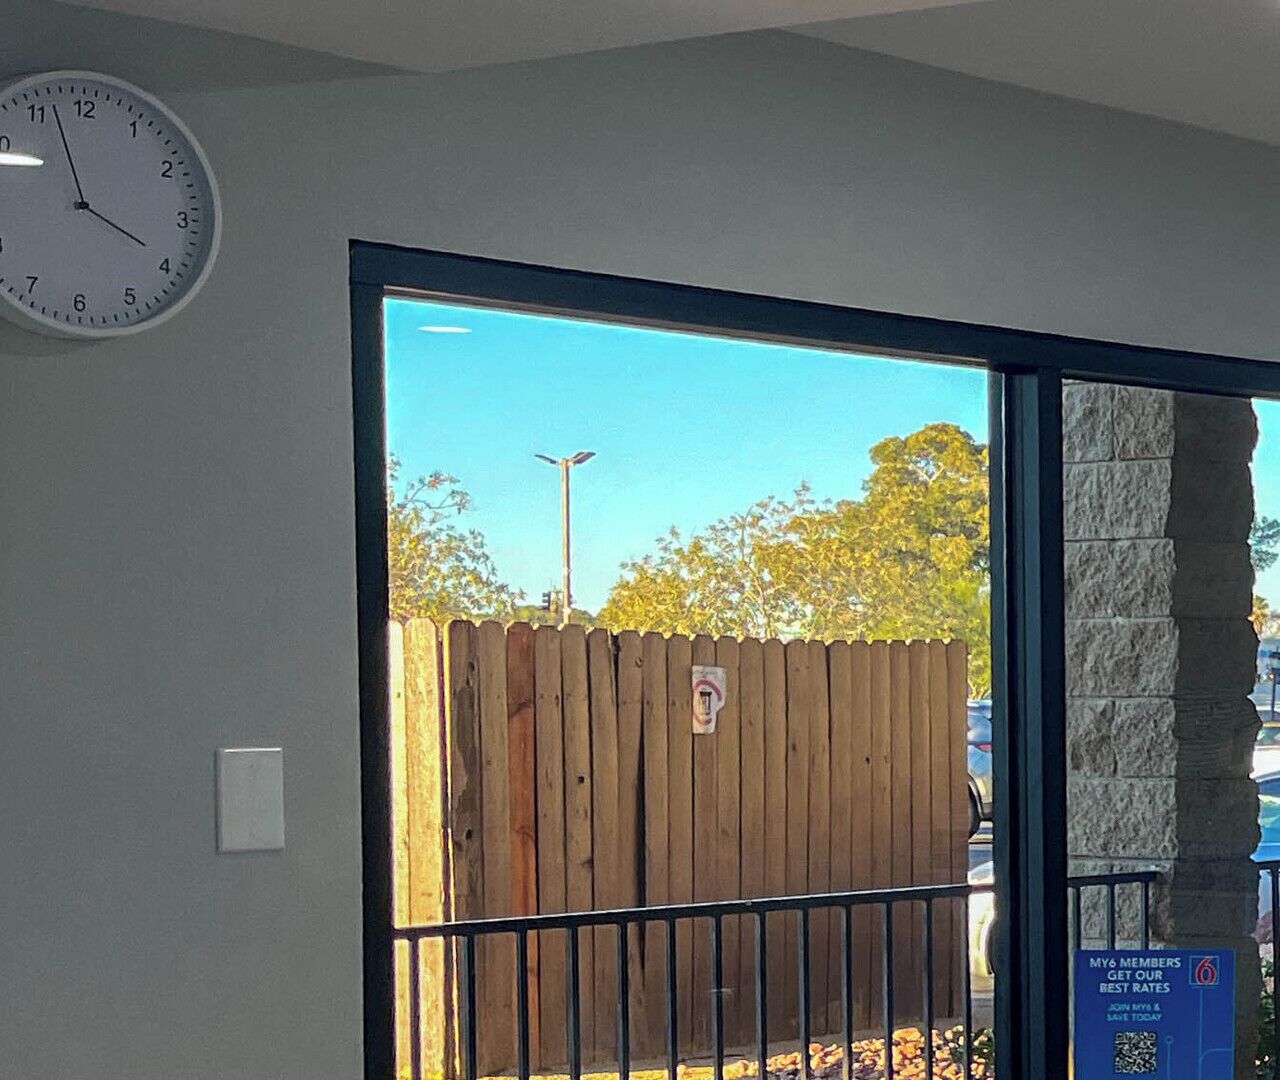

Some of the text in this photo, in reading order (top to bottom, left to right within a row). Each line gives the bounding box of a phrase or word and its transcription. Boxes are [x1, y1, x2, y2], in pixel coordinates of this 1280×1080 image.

[27, 104, 45, 123] 11
[73, 100, 96, 118] 12
[129, 120, 137, 138] 1
[161, 160, 173, 178] 2
[177, 211, 188, 229] 3
[159, 258, 171, 274] 4
[26, 276, 38, 294] 7
[73, 294, 86, 312] 6
[124, 288, 137, 305] 5
[1089, 957, 1181, 968] MY6 MEMBERS
[1195, 955, 1217, 985] 6
[1107, 970, 1163, 981] GET OUR
[1100, 982, 1170, 993] BEST RATES
[1108, 1003, 1130, 1011] JOIN
[1106, 1013, 1162, 1021] SAVE TODAY
